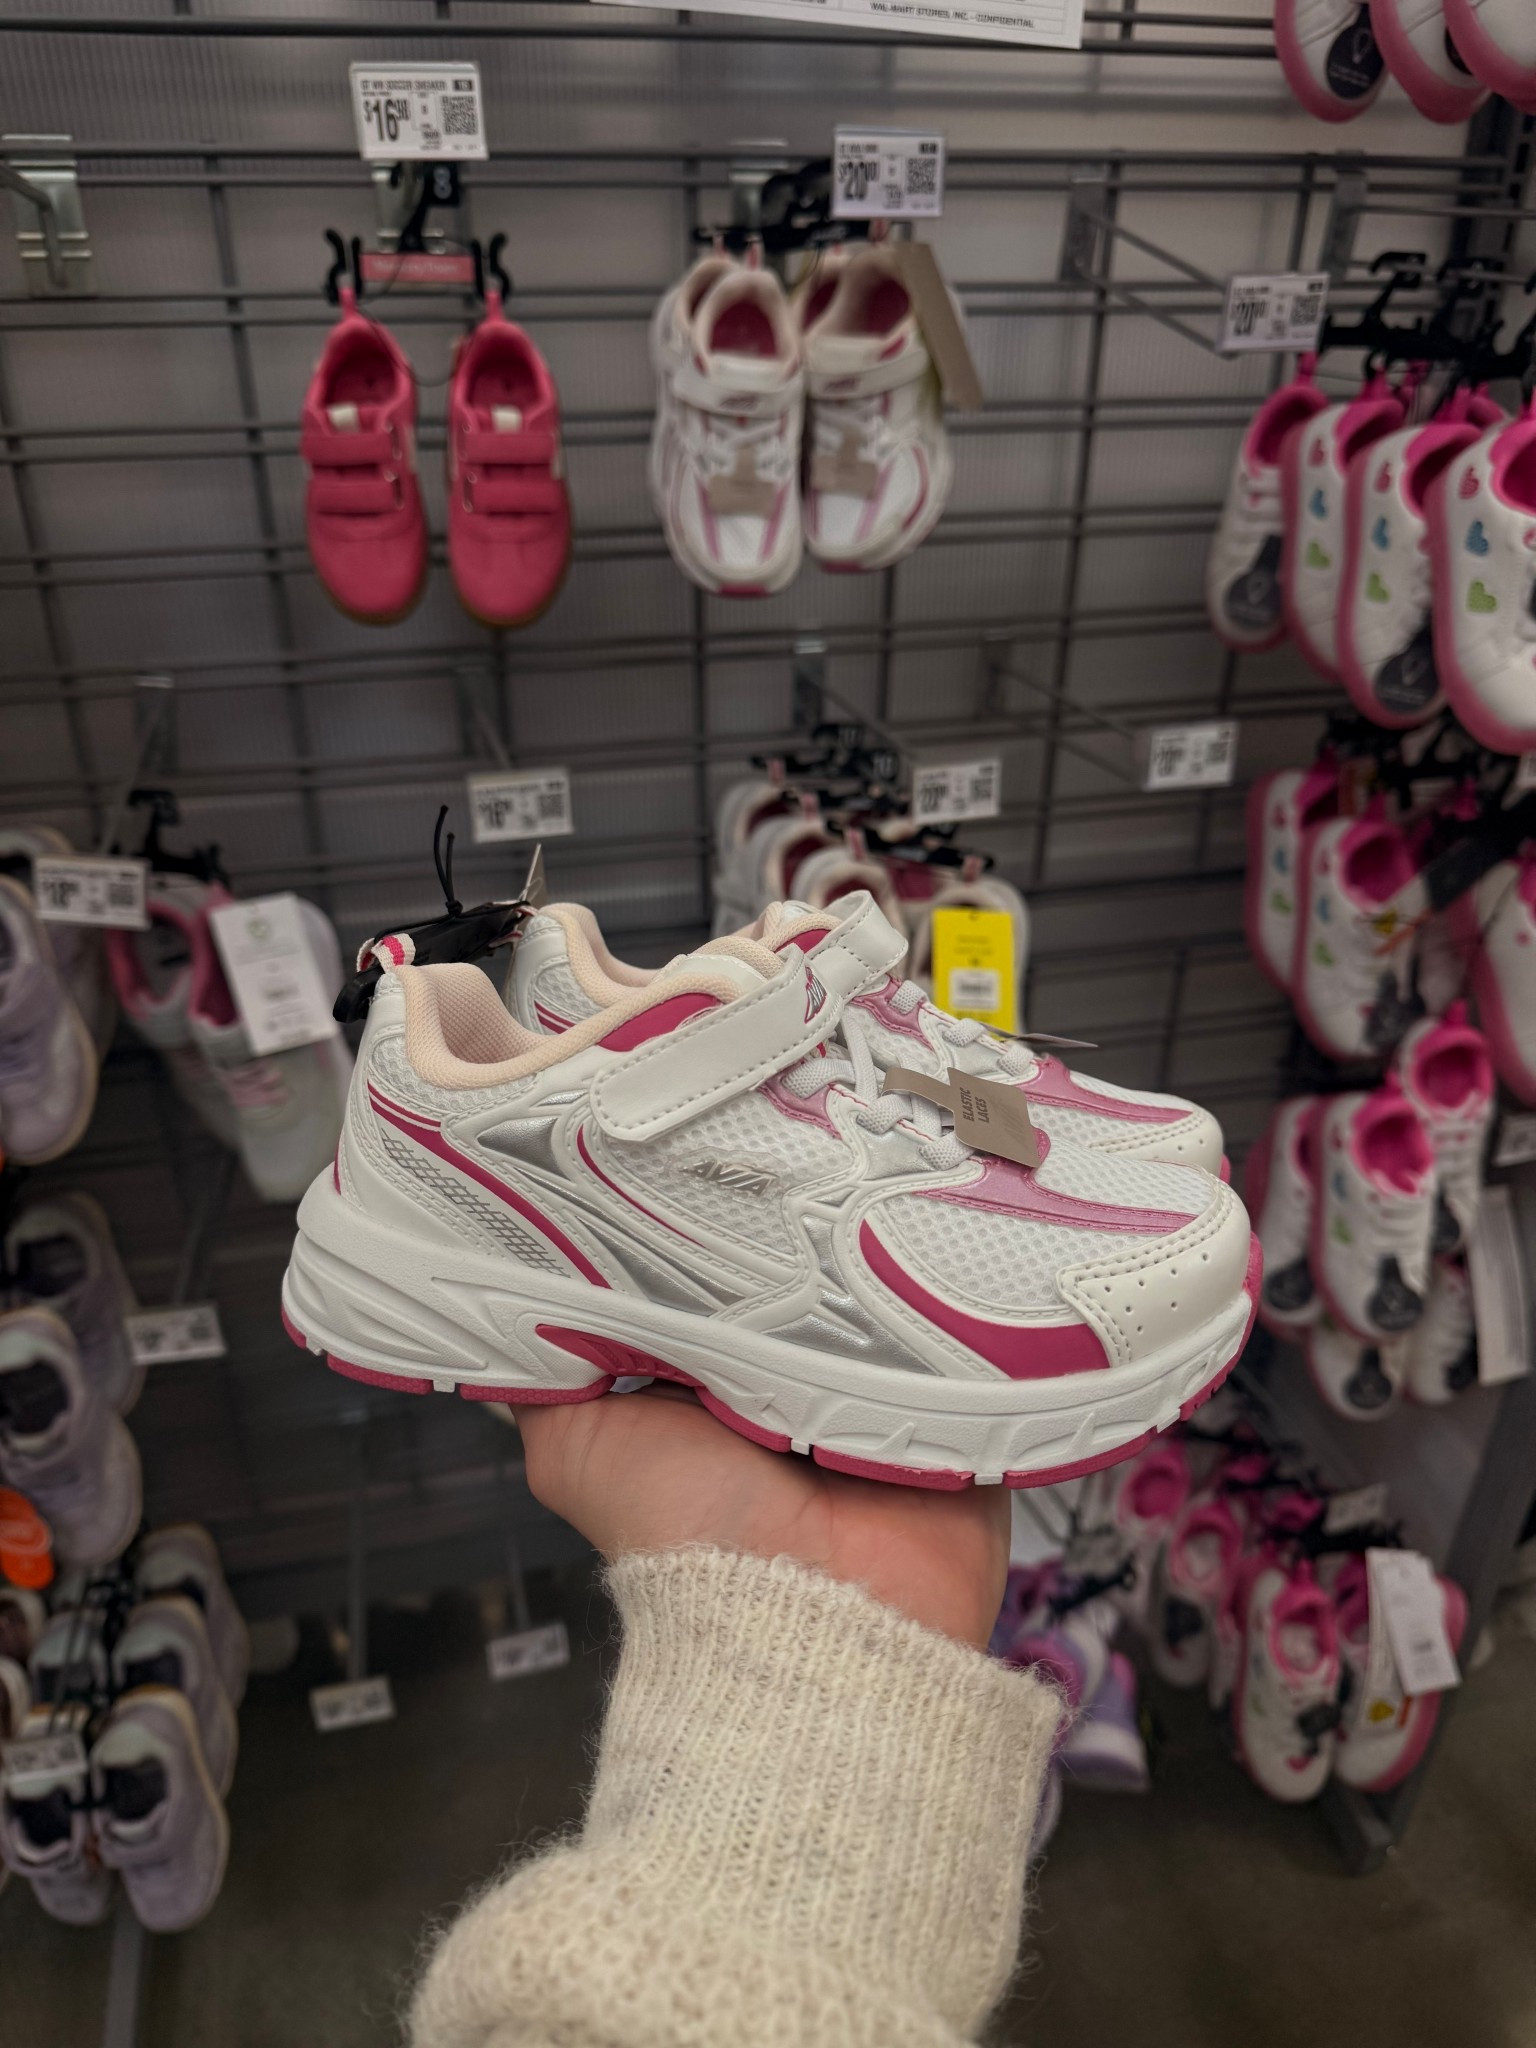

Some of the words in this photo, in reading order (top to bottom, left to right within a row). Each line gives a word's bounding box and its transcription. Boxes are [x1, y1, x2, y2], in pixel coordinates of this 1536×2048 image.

[976, 13, 1035, 29] CONFIDENTIAL
[959, 1086, 975, 1123] ELASTIC
[974, 1096, 990, 1123] LACES
[677, 1158, 779, 1198] AVIA
